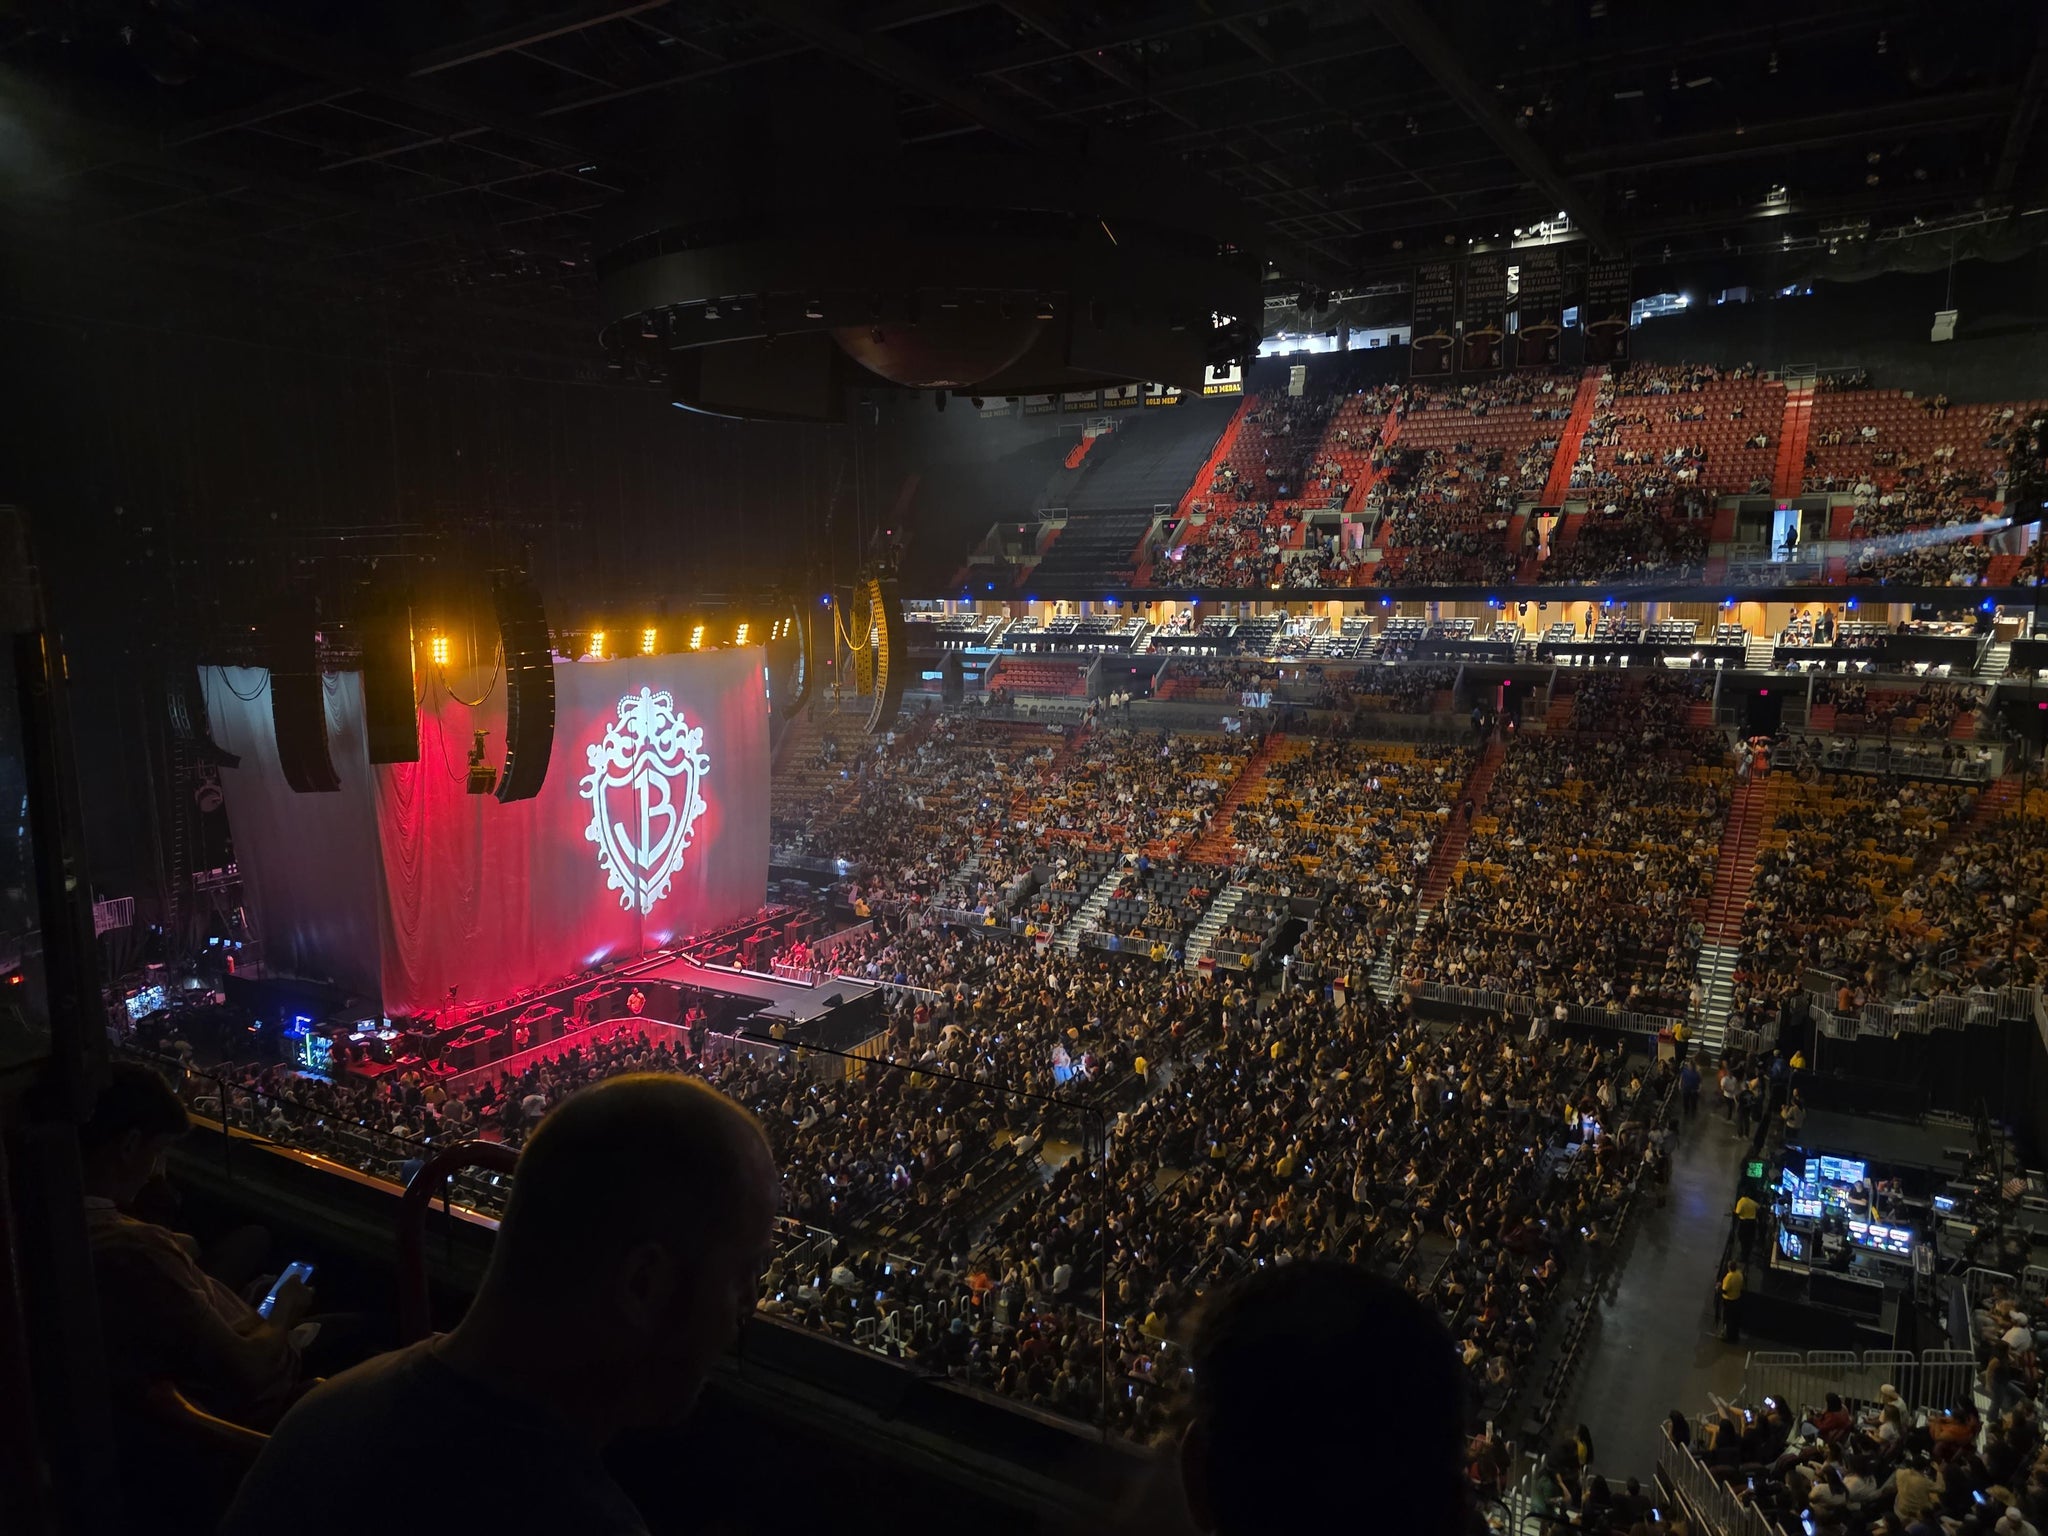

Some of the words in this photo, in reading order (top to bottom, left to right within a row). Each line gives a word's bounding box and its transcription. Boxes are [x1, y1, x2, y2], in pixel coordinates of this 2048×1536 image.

[1203, 386, 1218, 395] GOLD
[1219, 384, 1241, 394] MEDAL
[1118, 398, 1138, 406] MEDAL
[1145, 397, 1160, 406] GOLD
